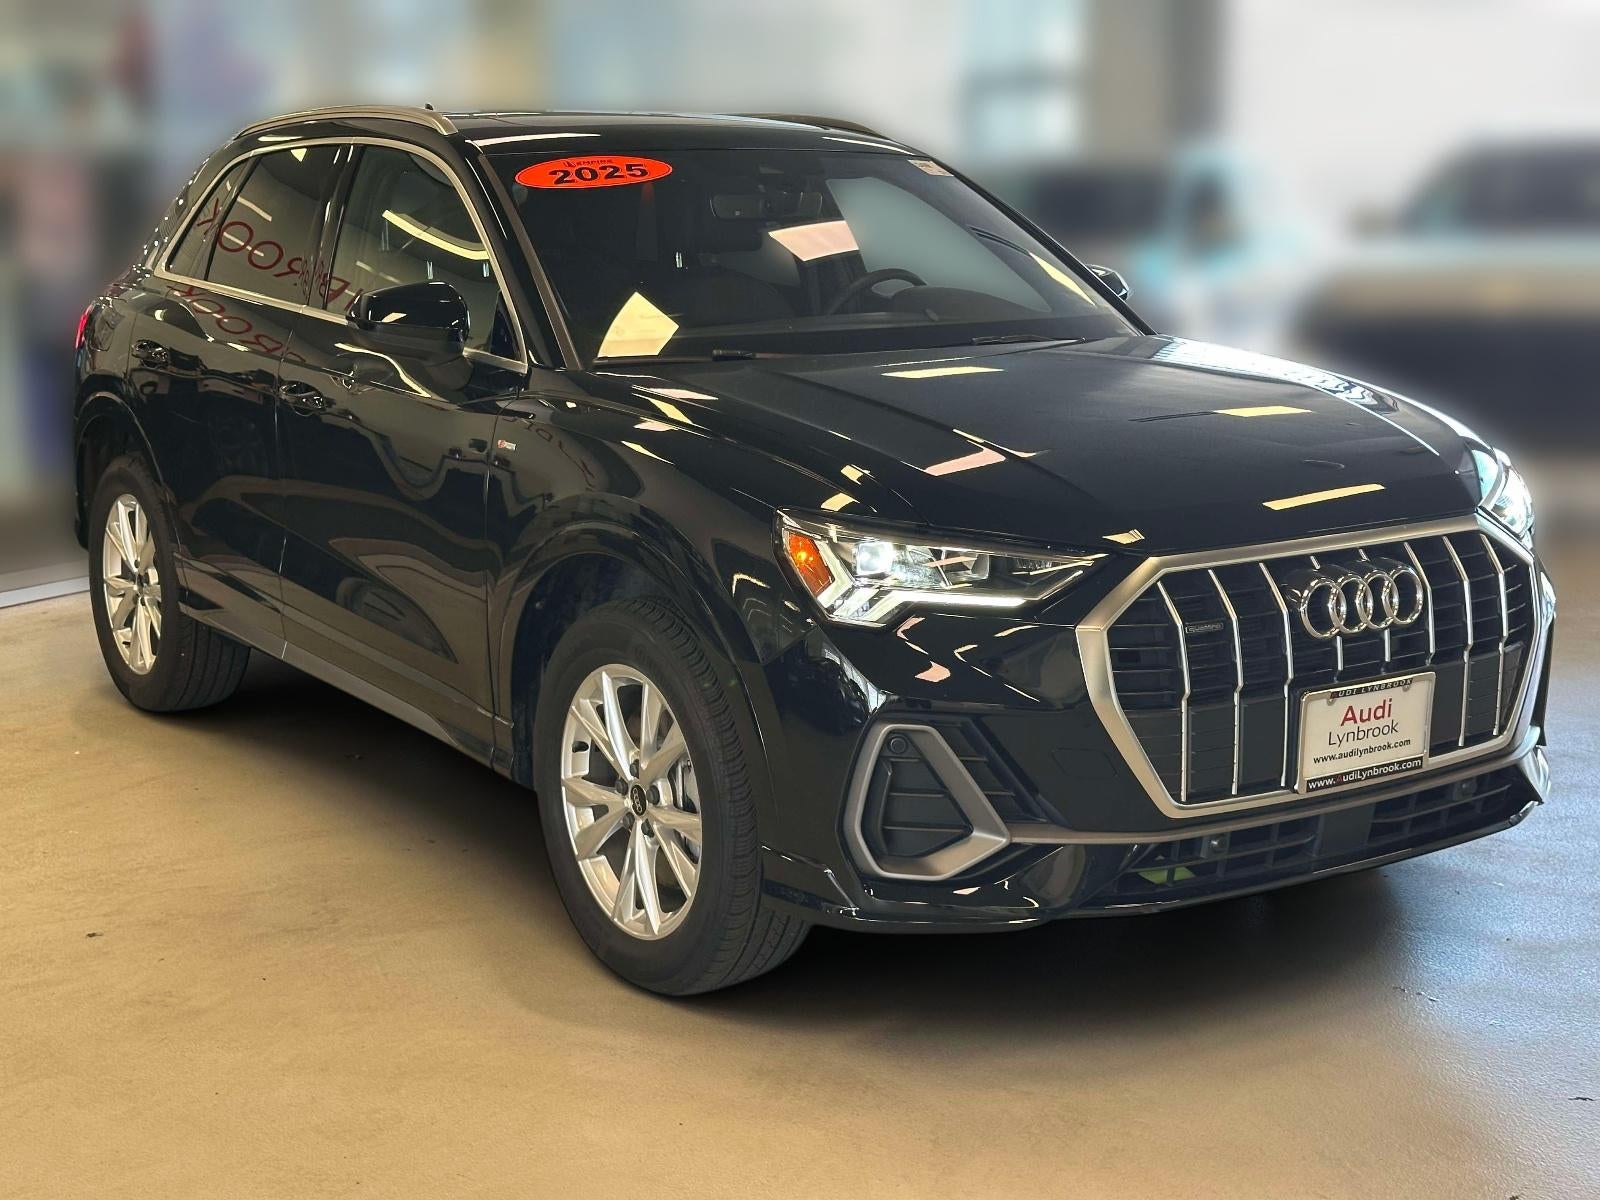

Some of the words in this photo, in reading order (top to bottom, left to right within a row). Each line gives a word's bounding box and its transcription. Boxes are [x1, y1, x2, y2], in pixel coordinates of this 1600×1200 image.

[549, 163, 649, 185] 2025
[1341, 698, 1393, 726] Audi
[1328, 720, 1399, 748] Lynbrook
[1313, 738, 1411, 764] www.audilynbrook.com
[1308, 759, 1422, 789] www.AudiLynbrook.com
